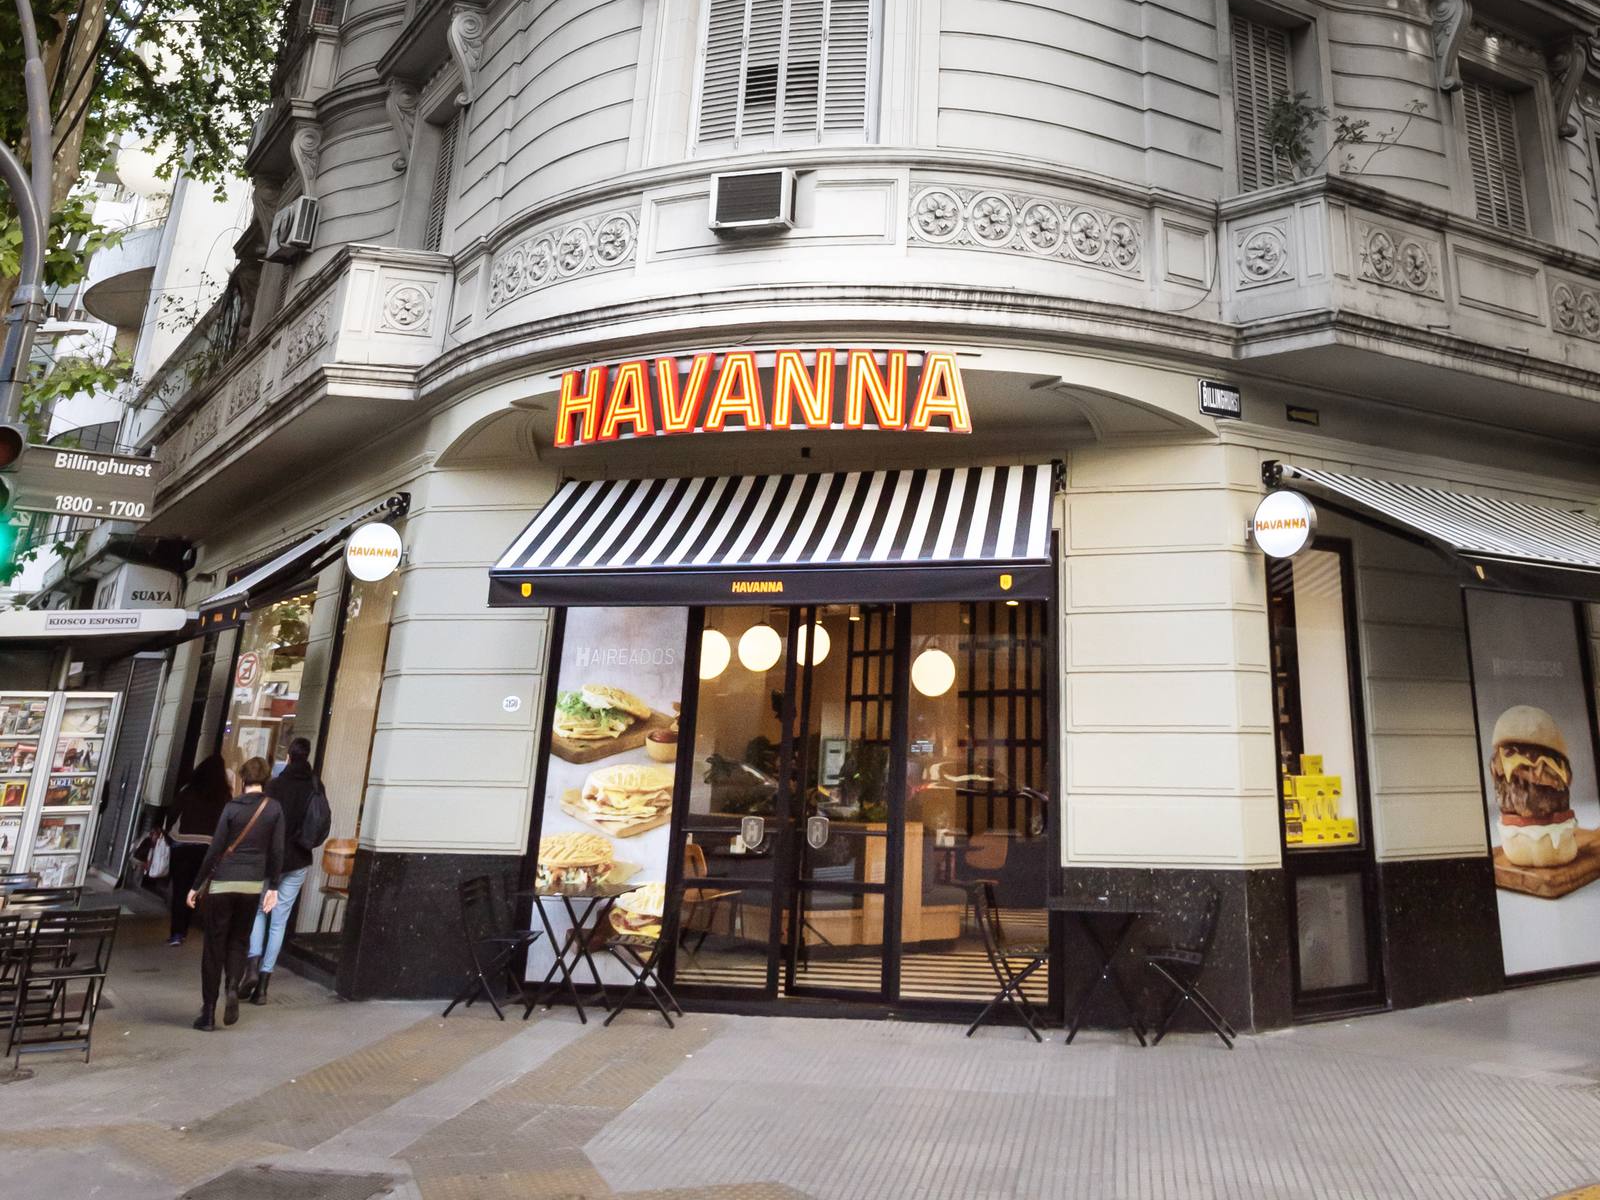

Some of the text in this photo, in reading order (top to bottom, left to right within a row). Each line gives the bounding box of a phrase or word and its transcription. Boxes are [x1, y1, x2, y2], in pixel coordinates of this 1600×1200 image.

[554, 348, 972, 447] HAVANNA
[55, 453, 152, 477] Billinghurst
[55, 495, 93, 513] 1800
[109, 501, 145, 517] 1700
[1255, 518, 1307, 531] HAVANNA
[349, 546, 398, 558] HAVANNA
[732, 581, 784, 593] HAVANNA
[131, 591, 172, 601] SUAYA
[89, 617, 138, 625] ESPOSITO
[575, 647, 675, 667] HAIREADOS
